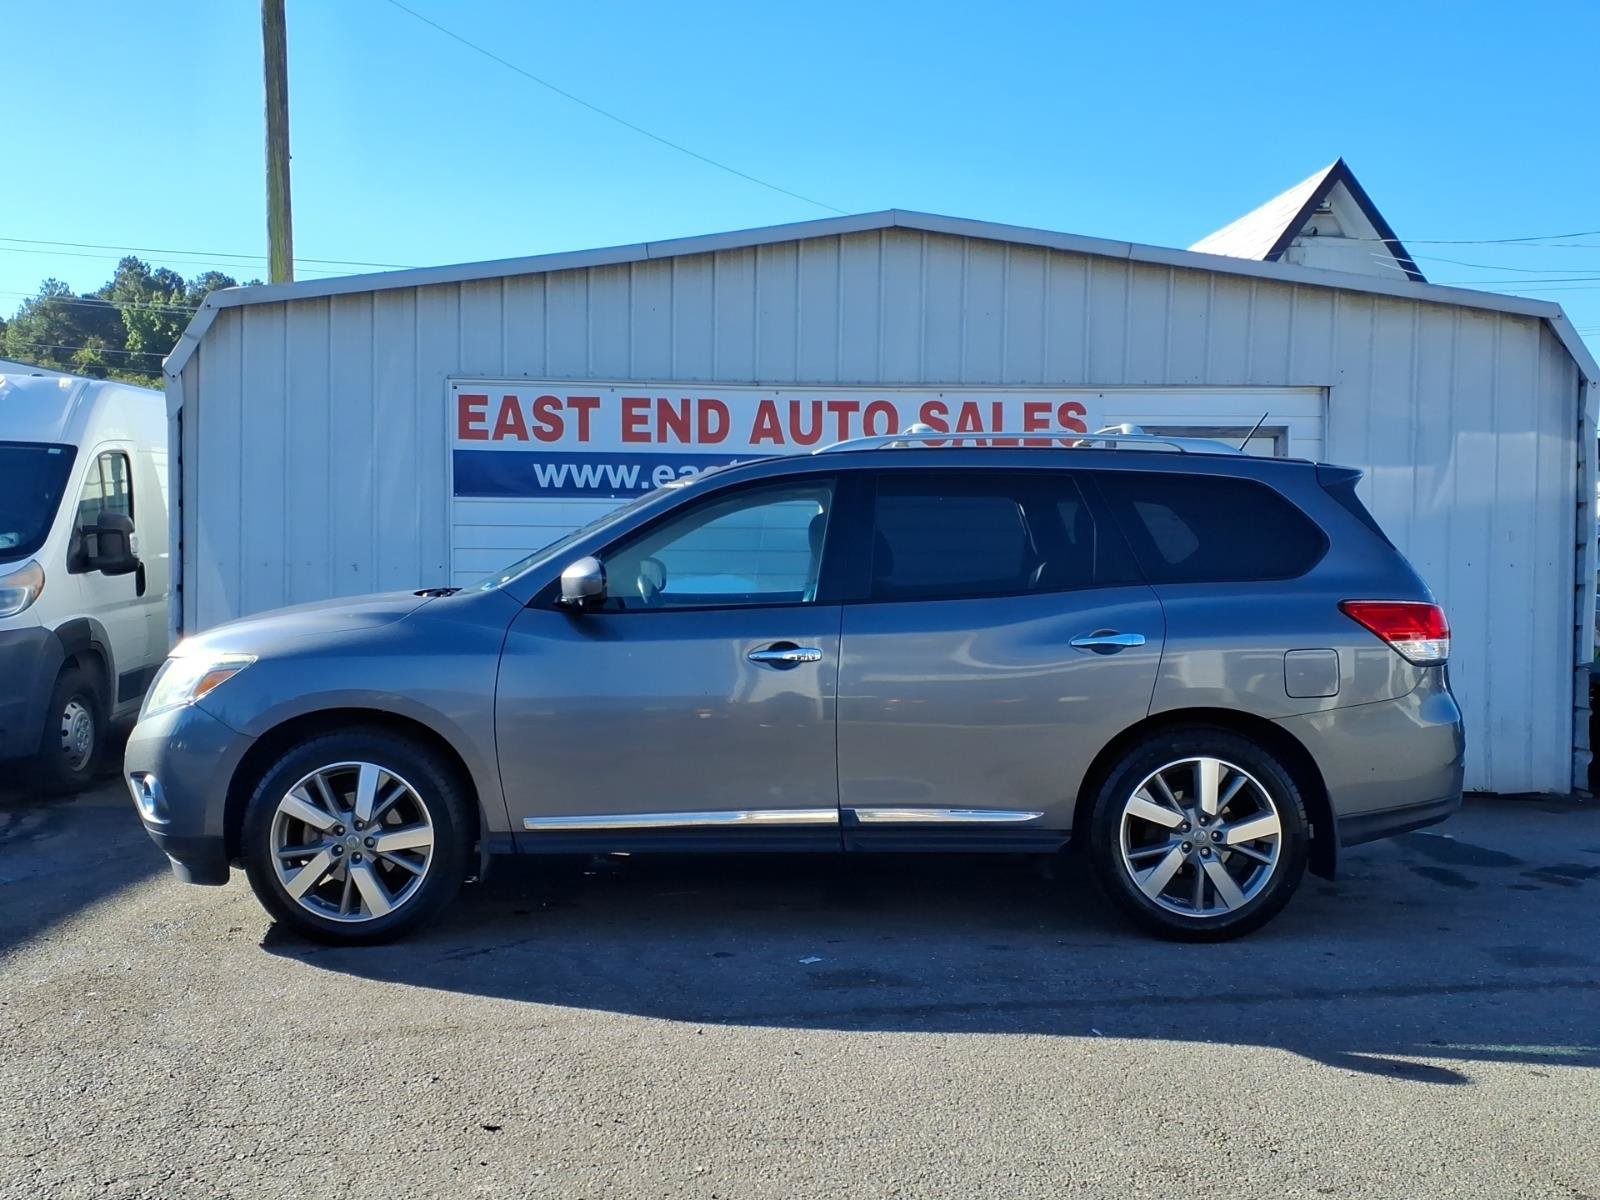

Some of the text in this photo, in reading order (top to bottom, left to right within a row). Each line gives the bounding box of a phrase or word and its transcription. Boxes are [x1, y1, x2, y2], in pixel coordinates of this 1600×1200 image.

[458, 394, 1087, 448] EAST END AUTO SALES
[533, 459, 738, 489] www.ea
